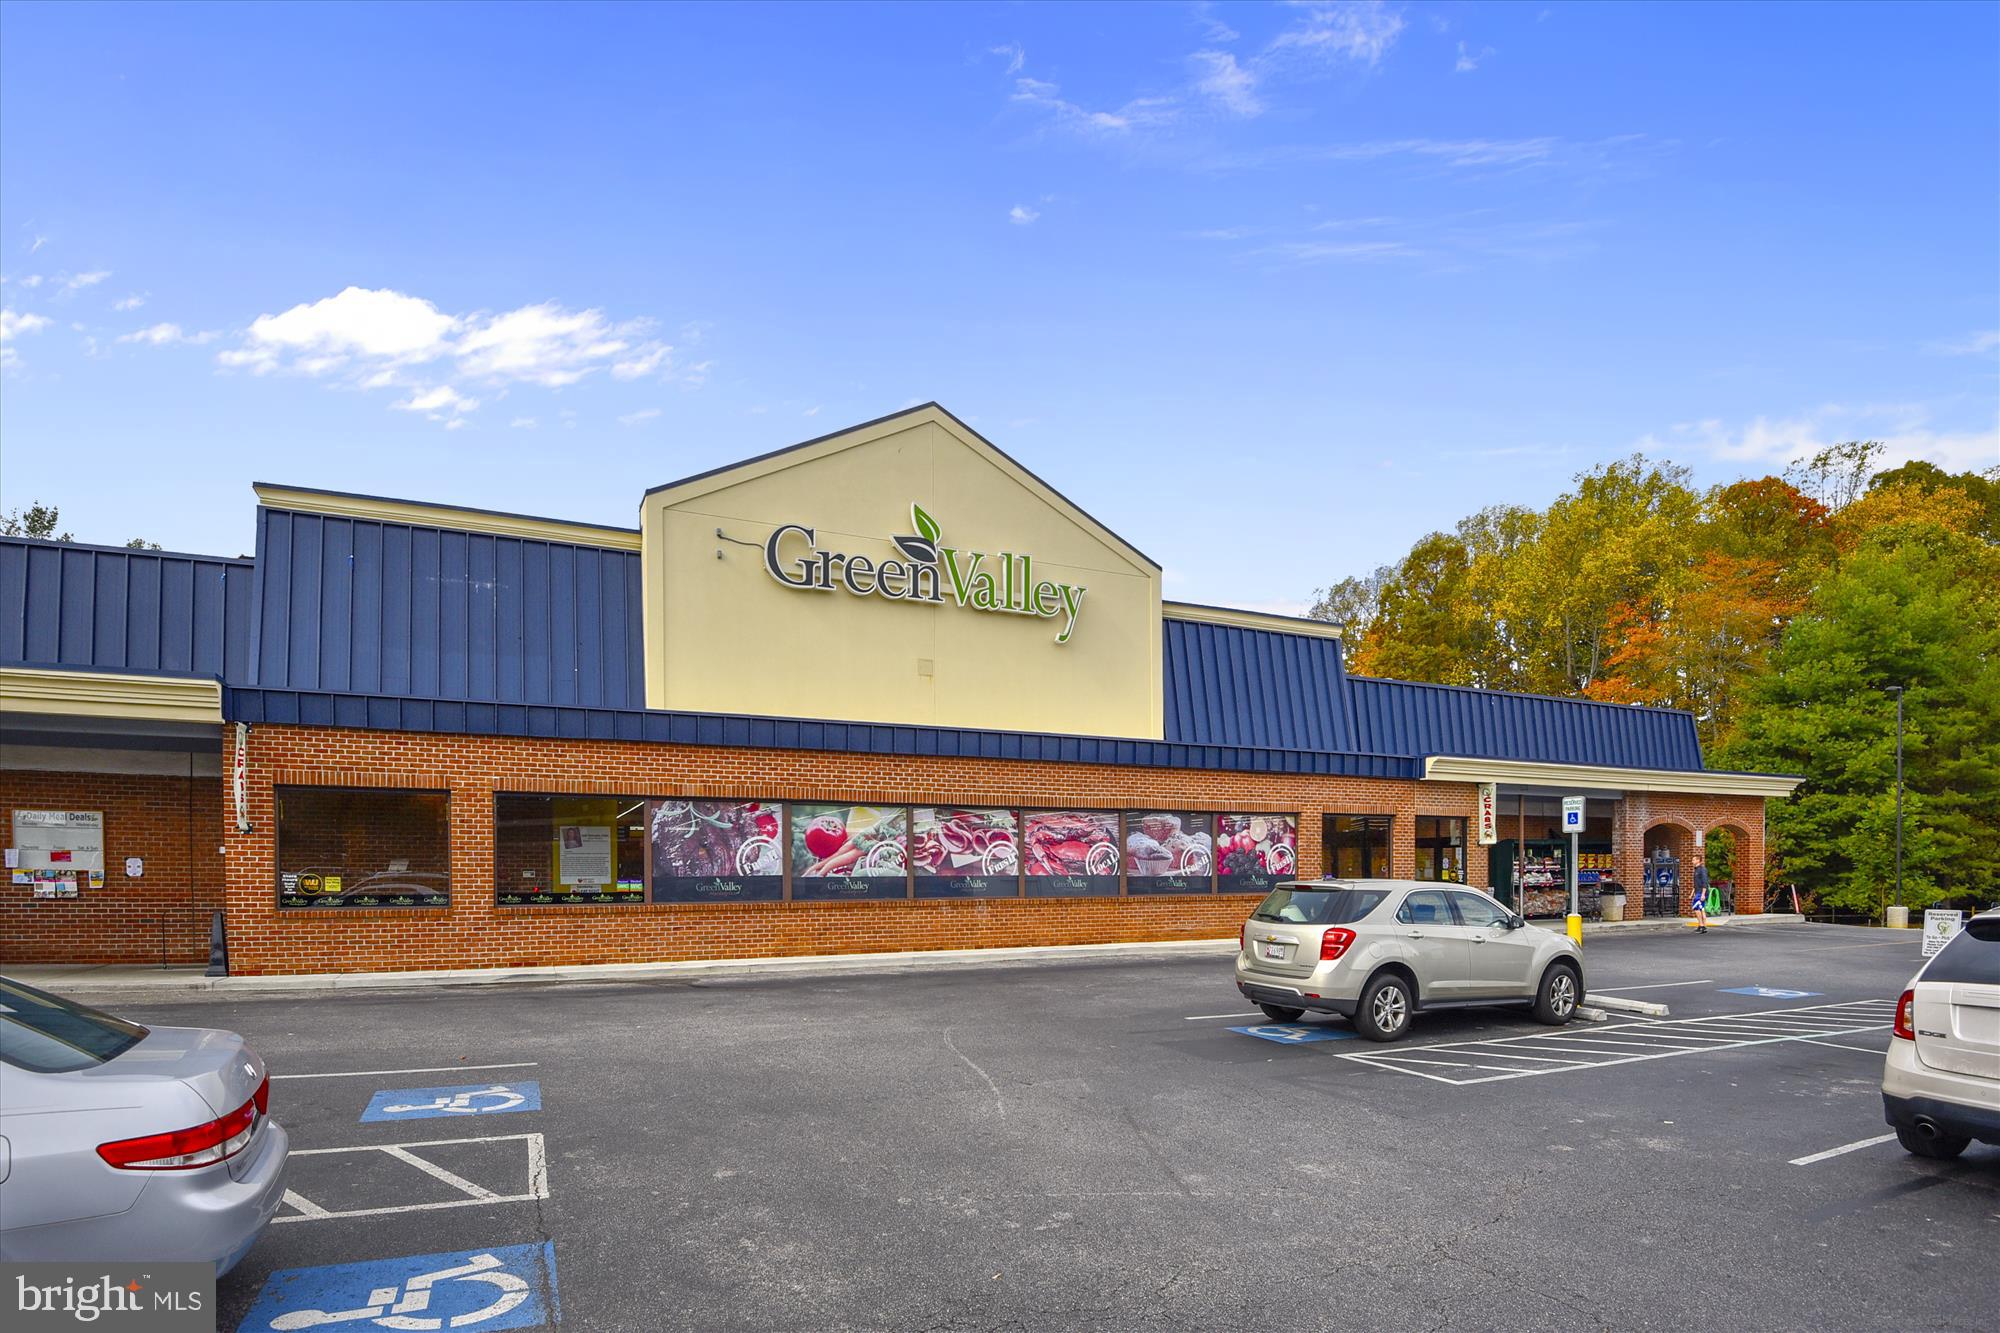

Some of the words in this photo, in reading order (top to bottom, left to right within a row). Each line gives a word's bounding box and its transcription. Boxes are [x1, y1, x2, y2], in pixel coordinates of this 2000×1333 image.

[26, 812, 47, 821] Daily
[49, 812, 67, 821] Meal
[69, 813, 91, 821] Deals
[1484, 796, 1492, 829] CRABS
[988, 852, 1017, 875] FRESH
[1091, 852, 1119, 875] LOCAL
[1918, 1029, 1947, 1039] EDGE
